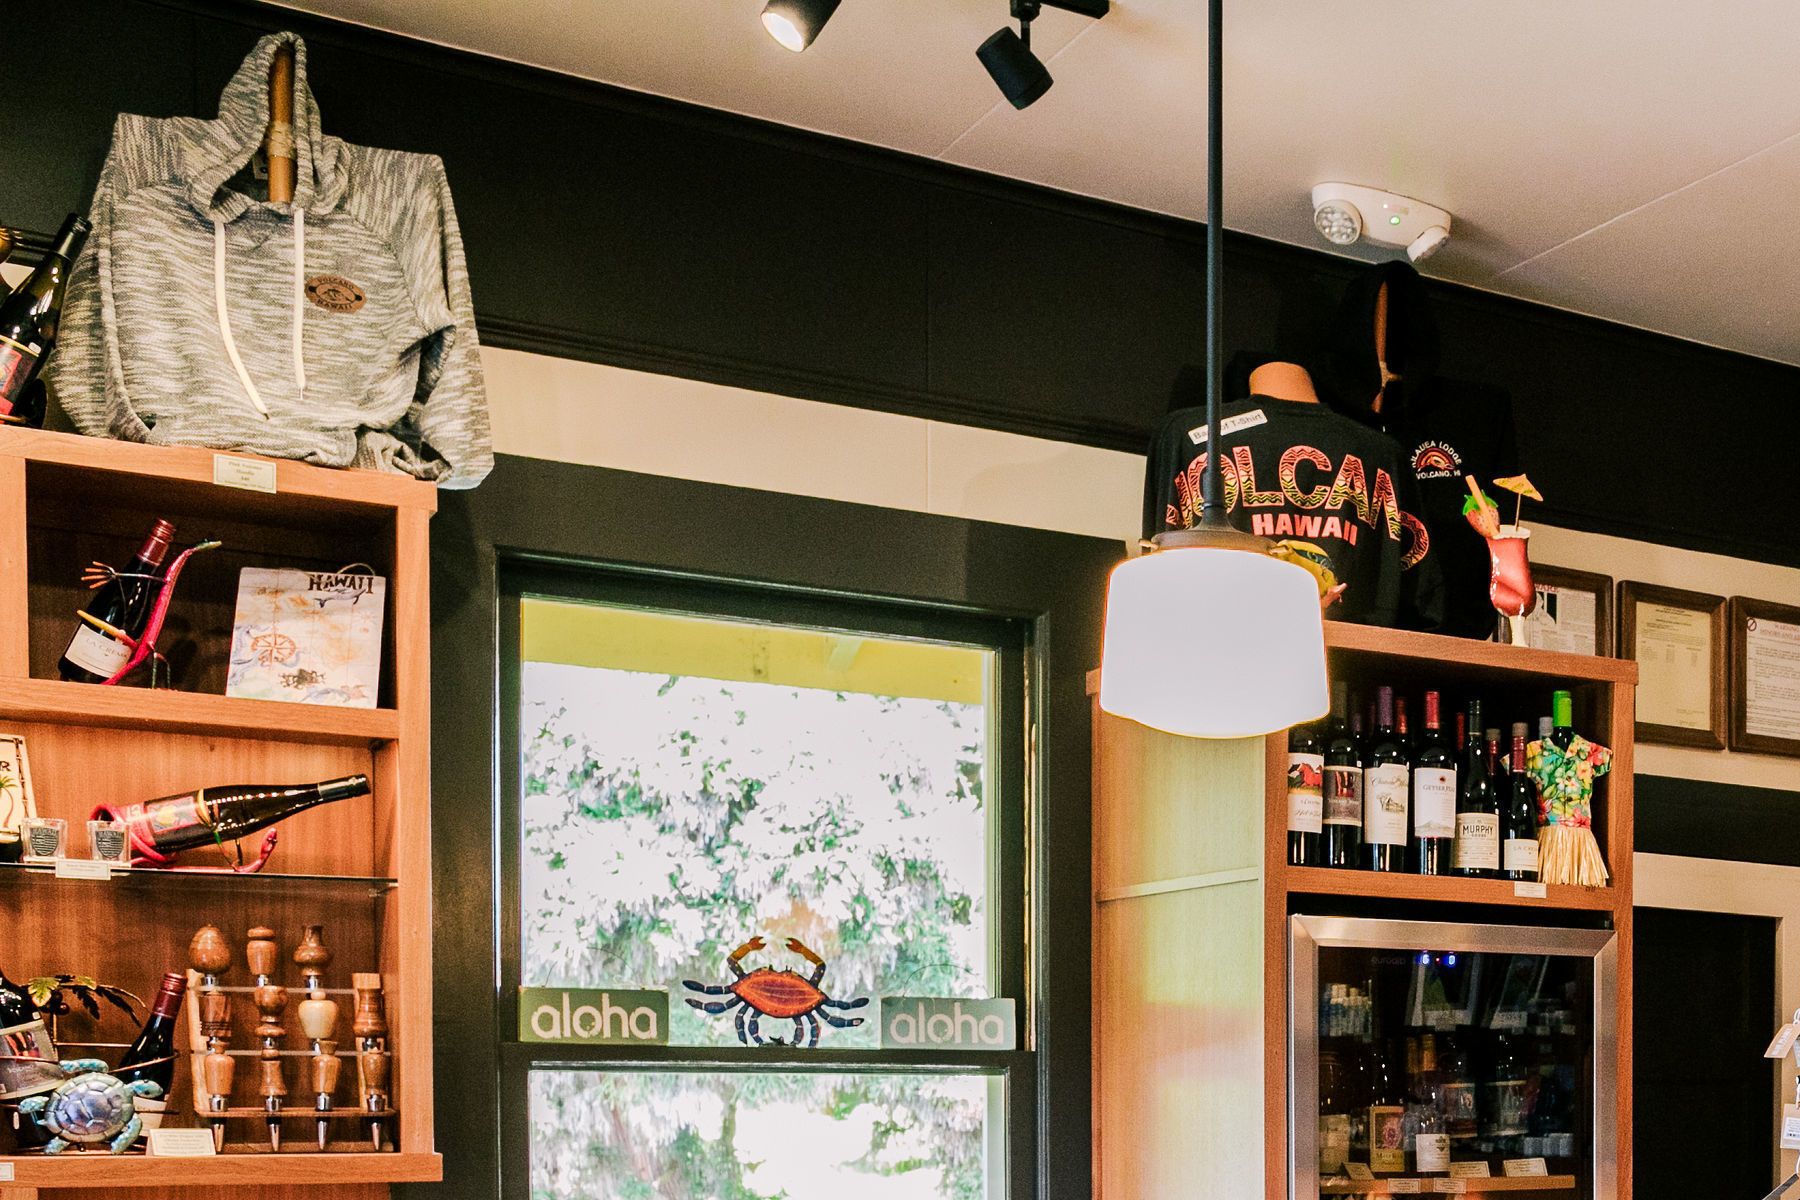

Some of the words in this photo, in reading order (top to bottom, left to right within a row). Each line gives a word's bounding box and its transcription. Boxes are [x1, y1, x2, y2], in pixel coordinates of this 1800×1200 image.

[1231, 413, 1262, 428] T-Shirt
[1251, 512, 1358, 546] HAWAII
[307, 573, 375, 595] HAWAII
[1462, 825, 1494, 836] MURPHY
[530, 992, 658, 1040] aloha
[889, 998, 1004, 1045] aloha
